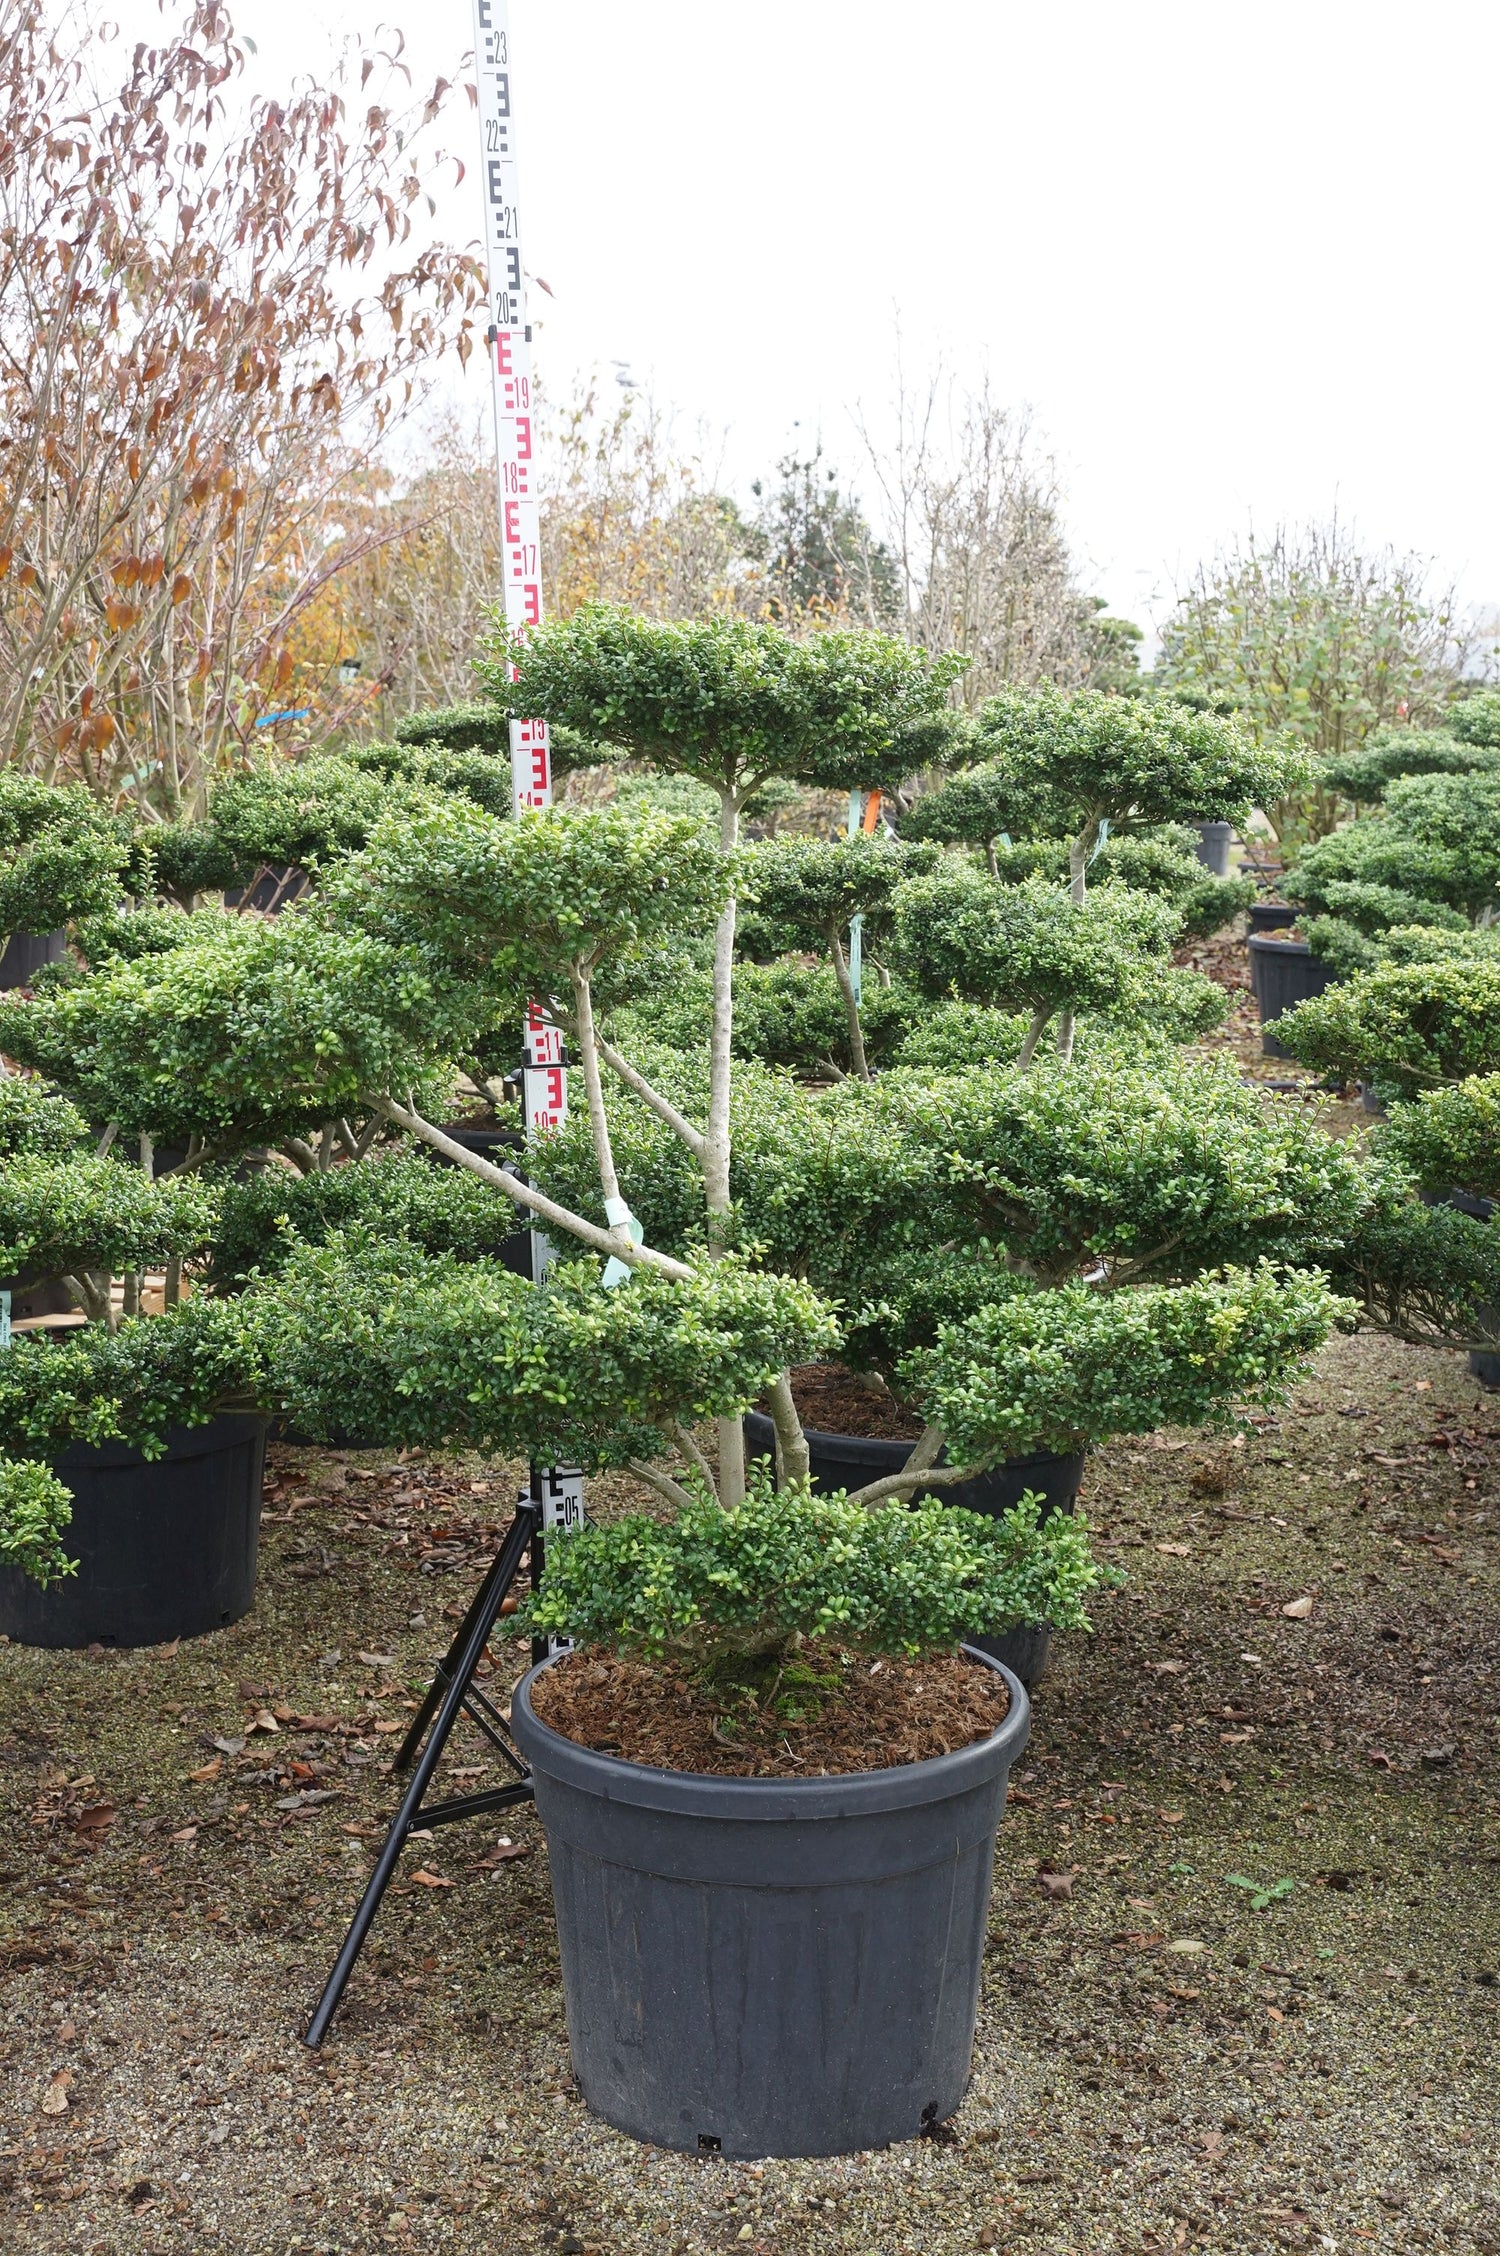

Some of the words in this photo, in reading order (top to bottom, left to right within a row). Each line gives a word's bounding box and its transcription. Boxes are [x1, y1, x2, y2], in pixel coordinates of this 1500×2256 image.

[493, 30, 507, 65] 23
[485, 119, 500, 152] 22
[504, 206, 518, 239] 21
[496, 291, 510, 324] 20
[513, 376, 529, 409] 19
[502, 461, 518, 494] 18
[521, 544, 536, 576] 17
[544, 1031, 561, 1061] 11
[564, 1495, 579, 1526] 05
